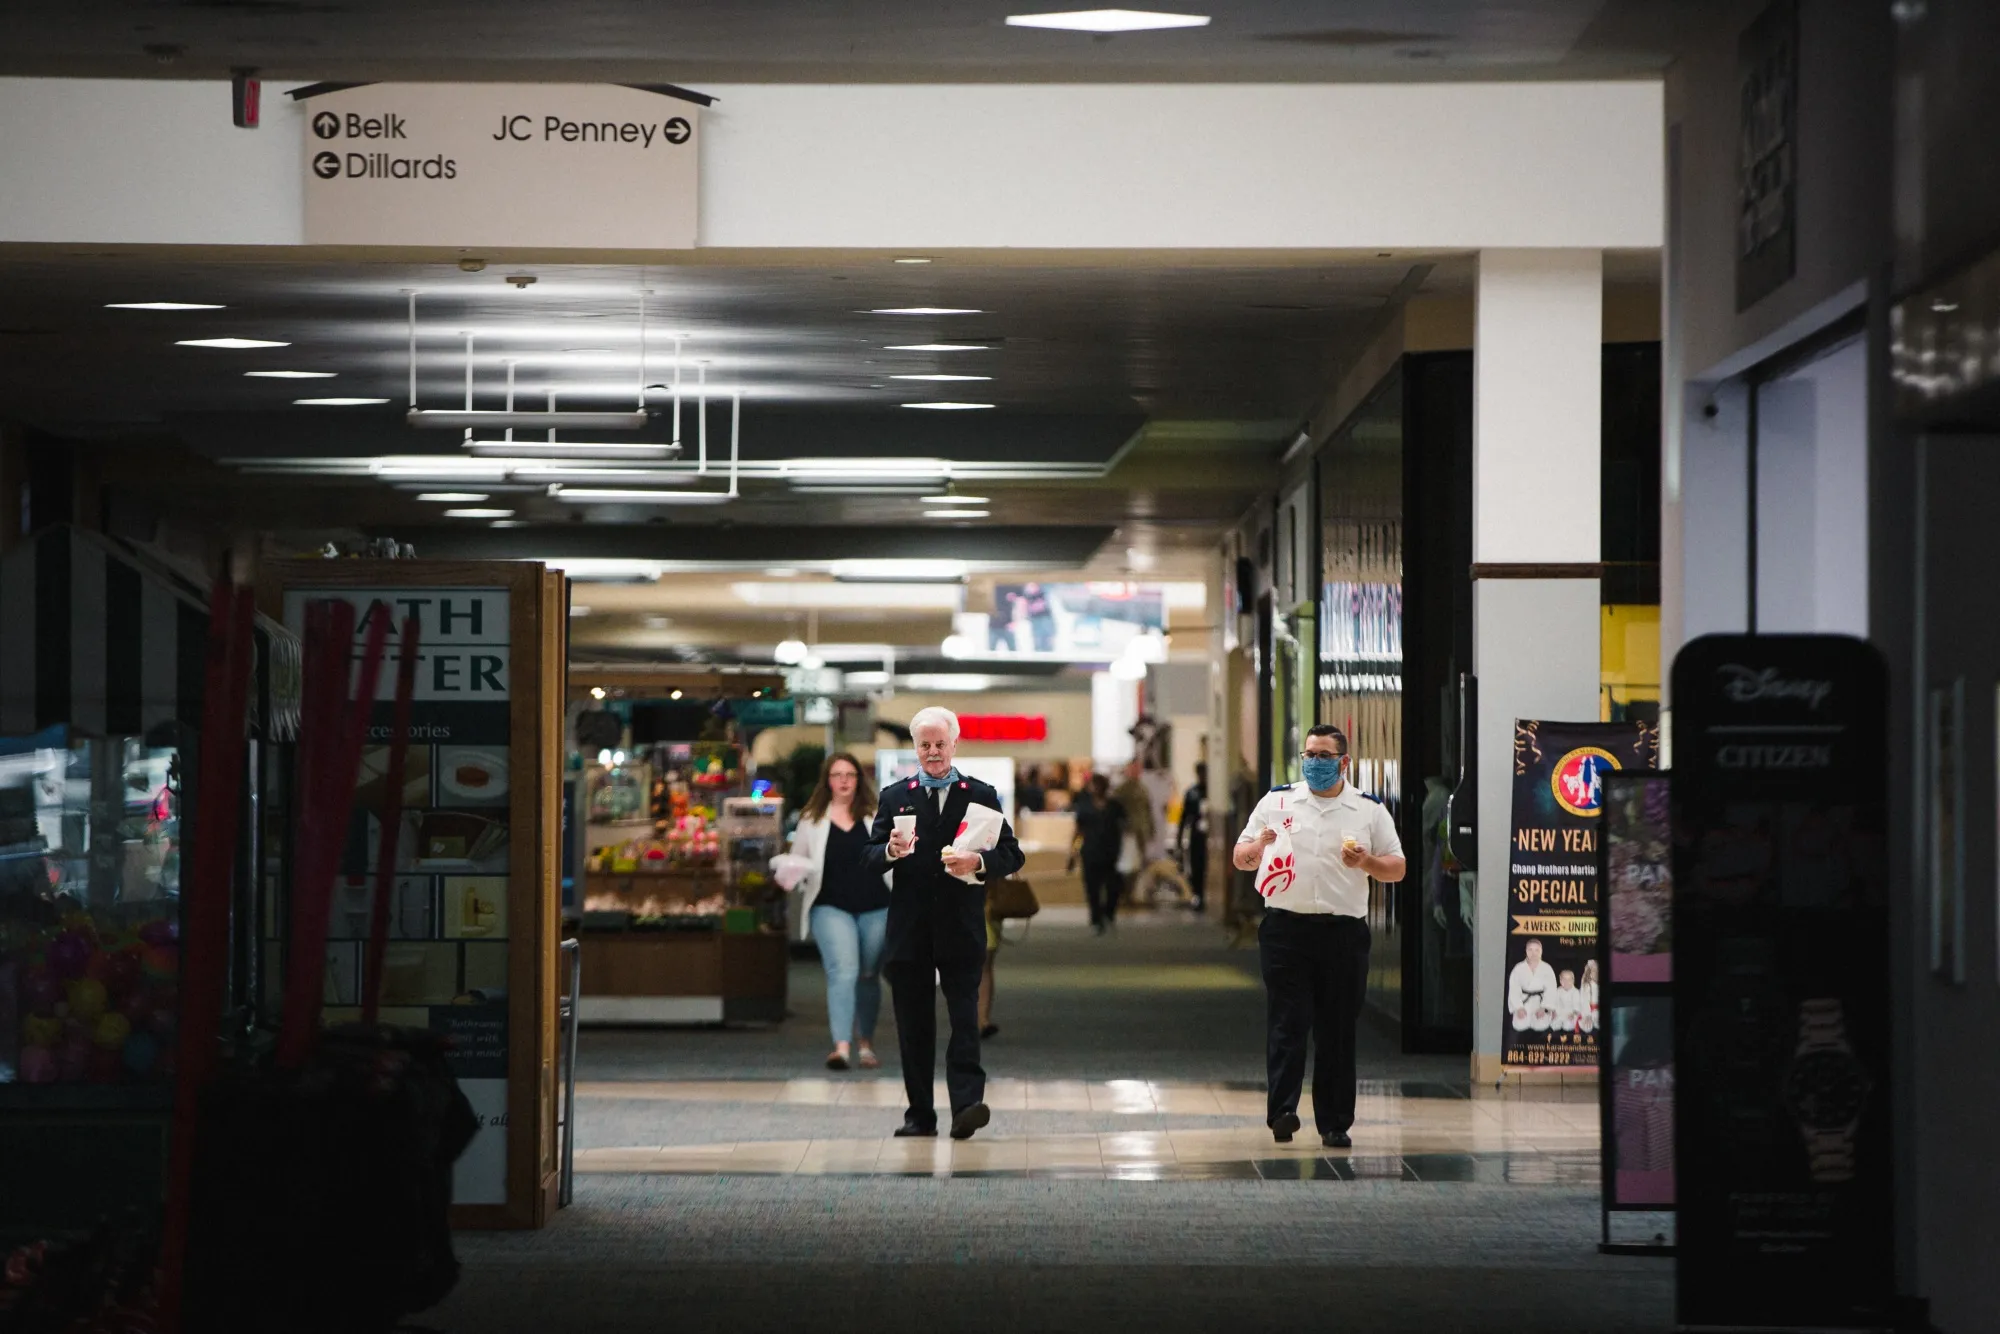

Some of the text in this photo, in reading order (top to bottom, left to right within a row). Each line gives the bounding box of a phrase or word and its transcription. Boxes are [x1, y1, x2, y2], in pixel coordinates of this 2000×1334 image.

[346, 113, 407, 138] Belk
[493, 115, 657, 148] JC Penney
[346, 153, 456, 179] Dillards
[318, 598, 483, 634] ATH
[1715, 745, 1830, 769] CITIZEN
[1512, 863, 1536, 876] Chang
[1537, 864, 1570, 876] Brothers
[1518, 879, 1588, 904] SPECIAL
[1523, 920, 1529, 931] 4
[1530, 920, 1561, 932] WEEKS
